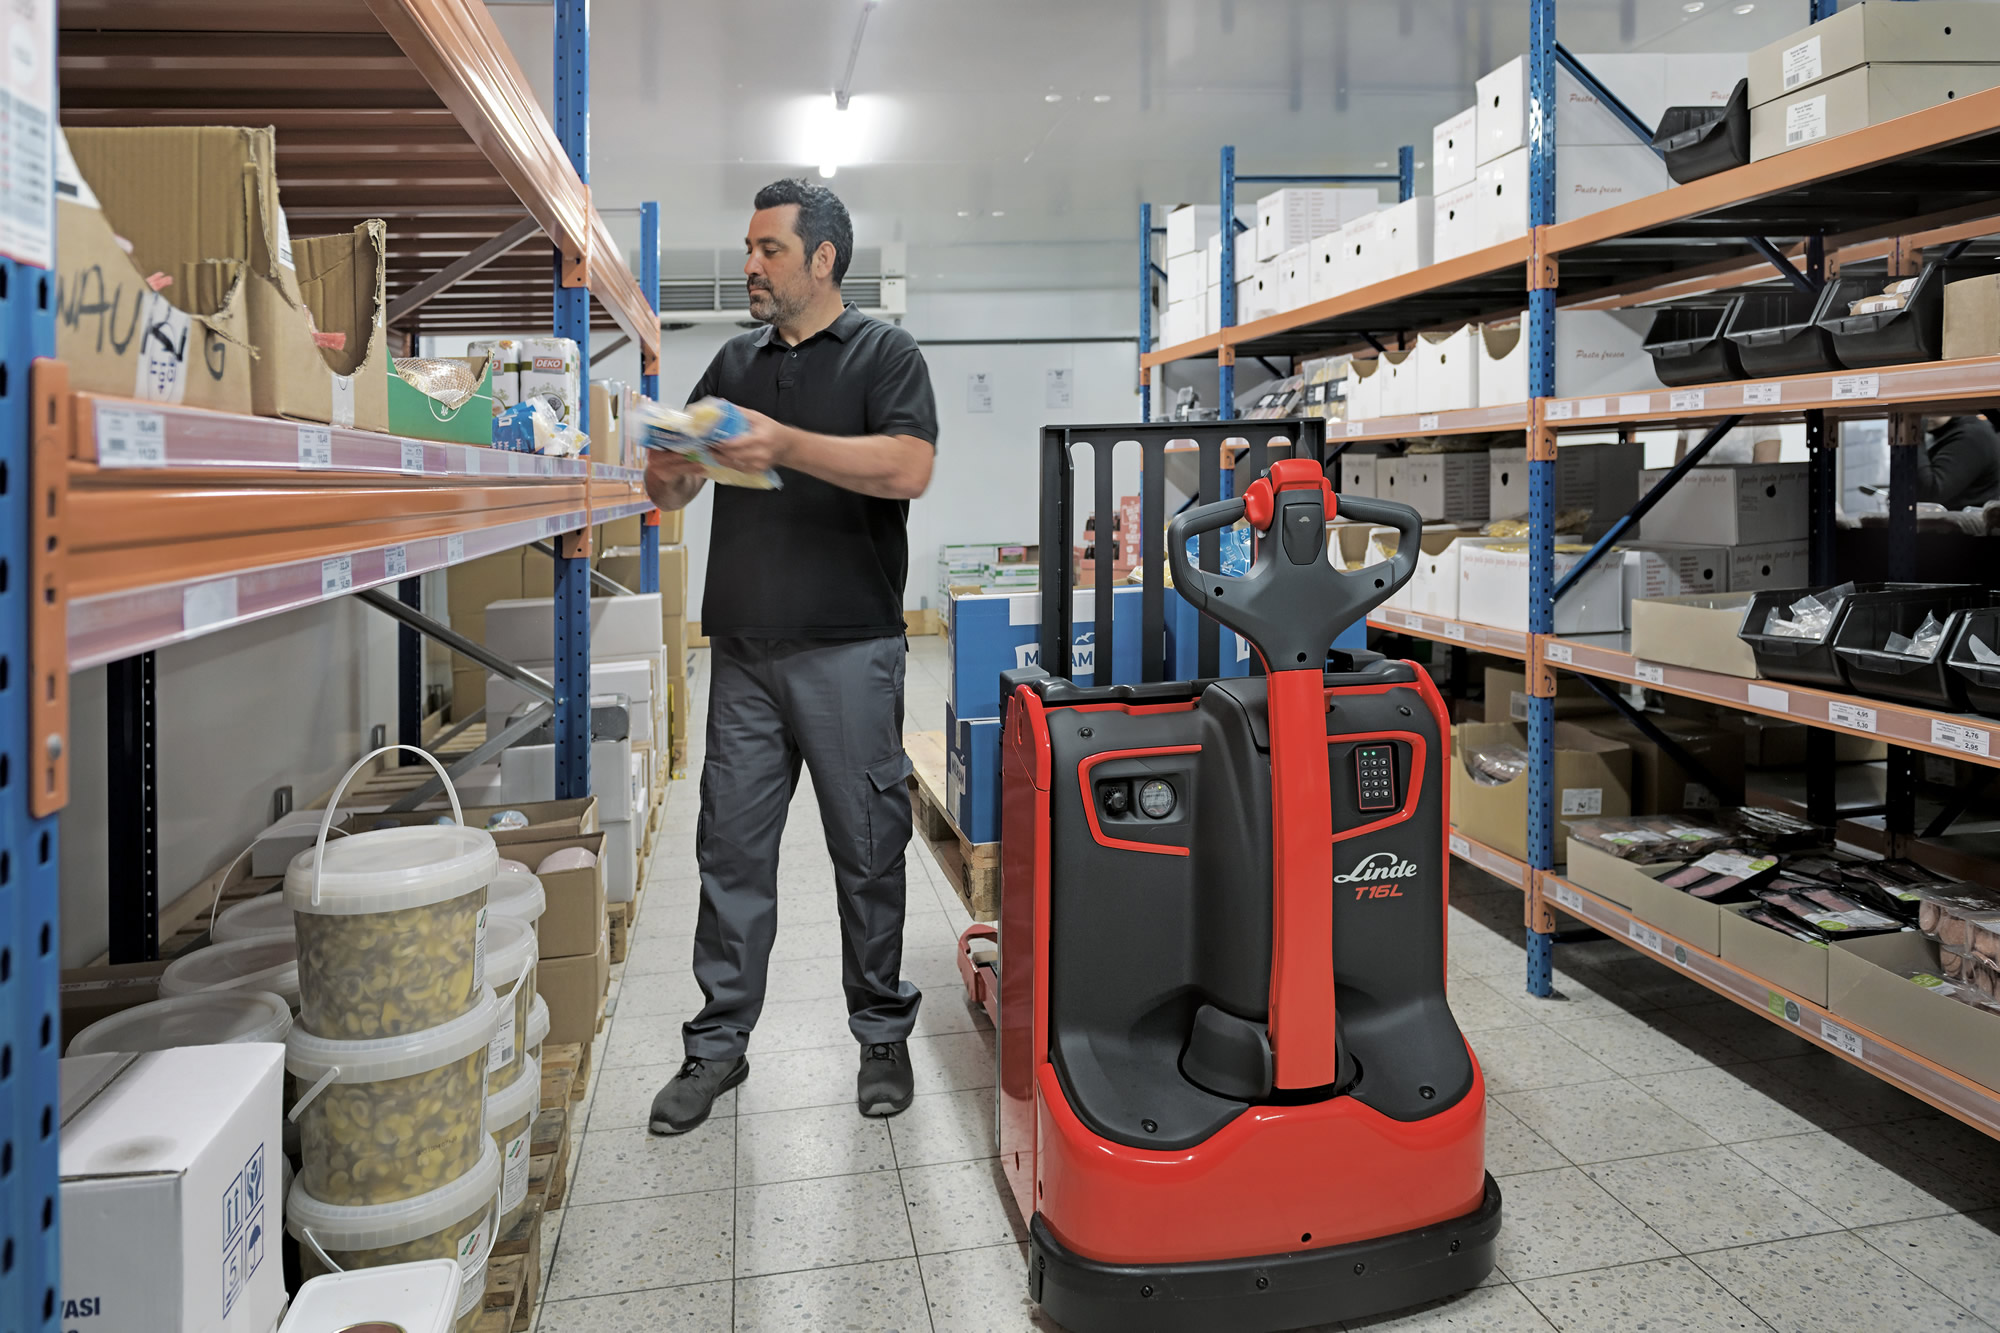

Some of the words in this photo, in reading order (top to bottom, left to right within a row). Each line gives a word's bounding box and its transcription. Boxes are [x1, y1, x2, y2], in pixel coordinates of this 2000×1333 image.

[535, 359, 561, 368] DEKO
[1025, 651, 1093, 667] MAM
[1856, 721, 1869, 729] 5,30
[1964, 730, 1979, 739] 2,76
[1964, 742, 1979, 751] 2,95
[1333, 852, 1417, 884] Linde
[1355, 884, 1403, 900] T16L
